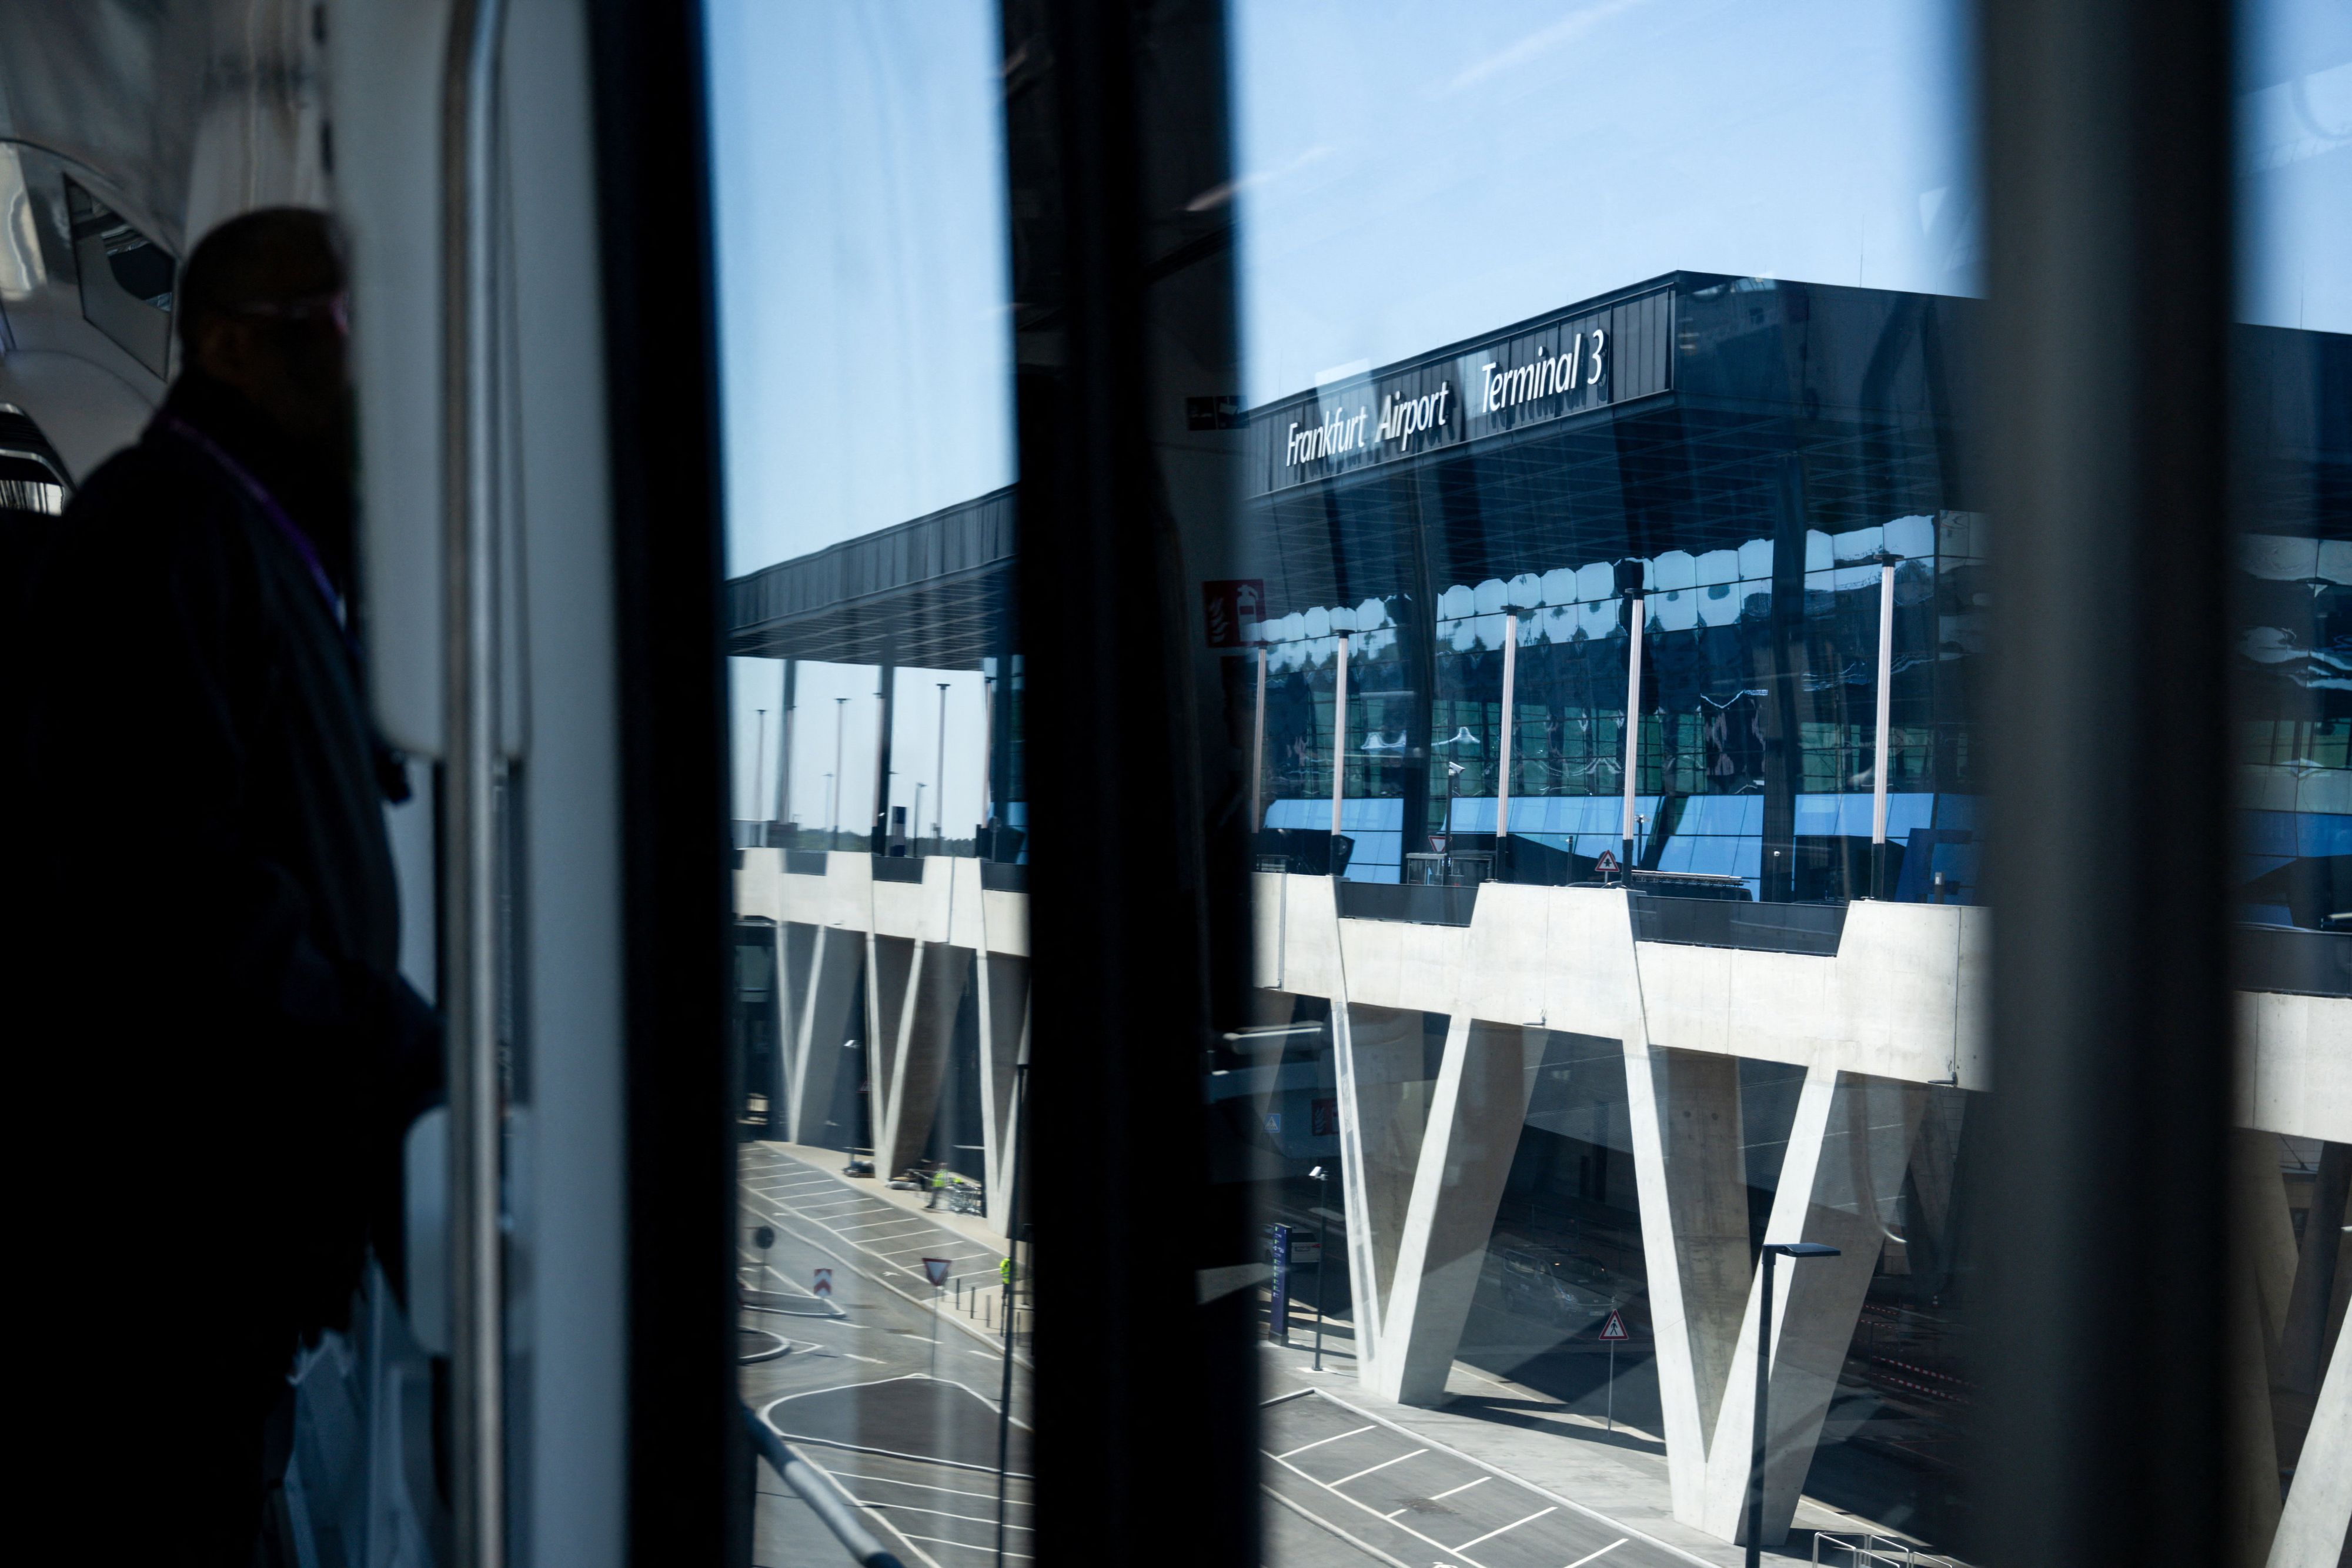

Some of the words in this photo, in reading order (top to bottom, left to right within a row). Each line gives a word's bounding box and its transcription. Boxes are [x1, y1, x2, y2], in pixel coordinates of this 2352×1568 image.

[1286, 406, 1368, 466] Frankfurt
[1374, 381, 1449, 452] Airport
[1482, 333, 1581, 413] Terminal
[1588, 329, 1604, 385] 3
